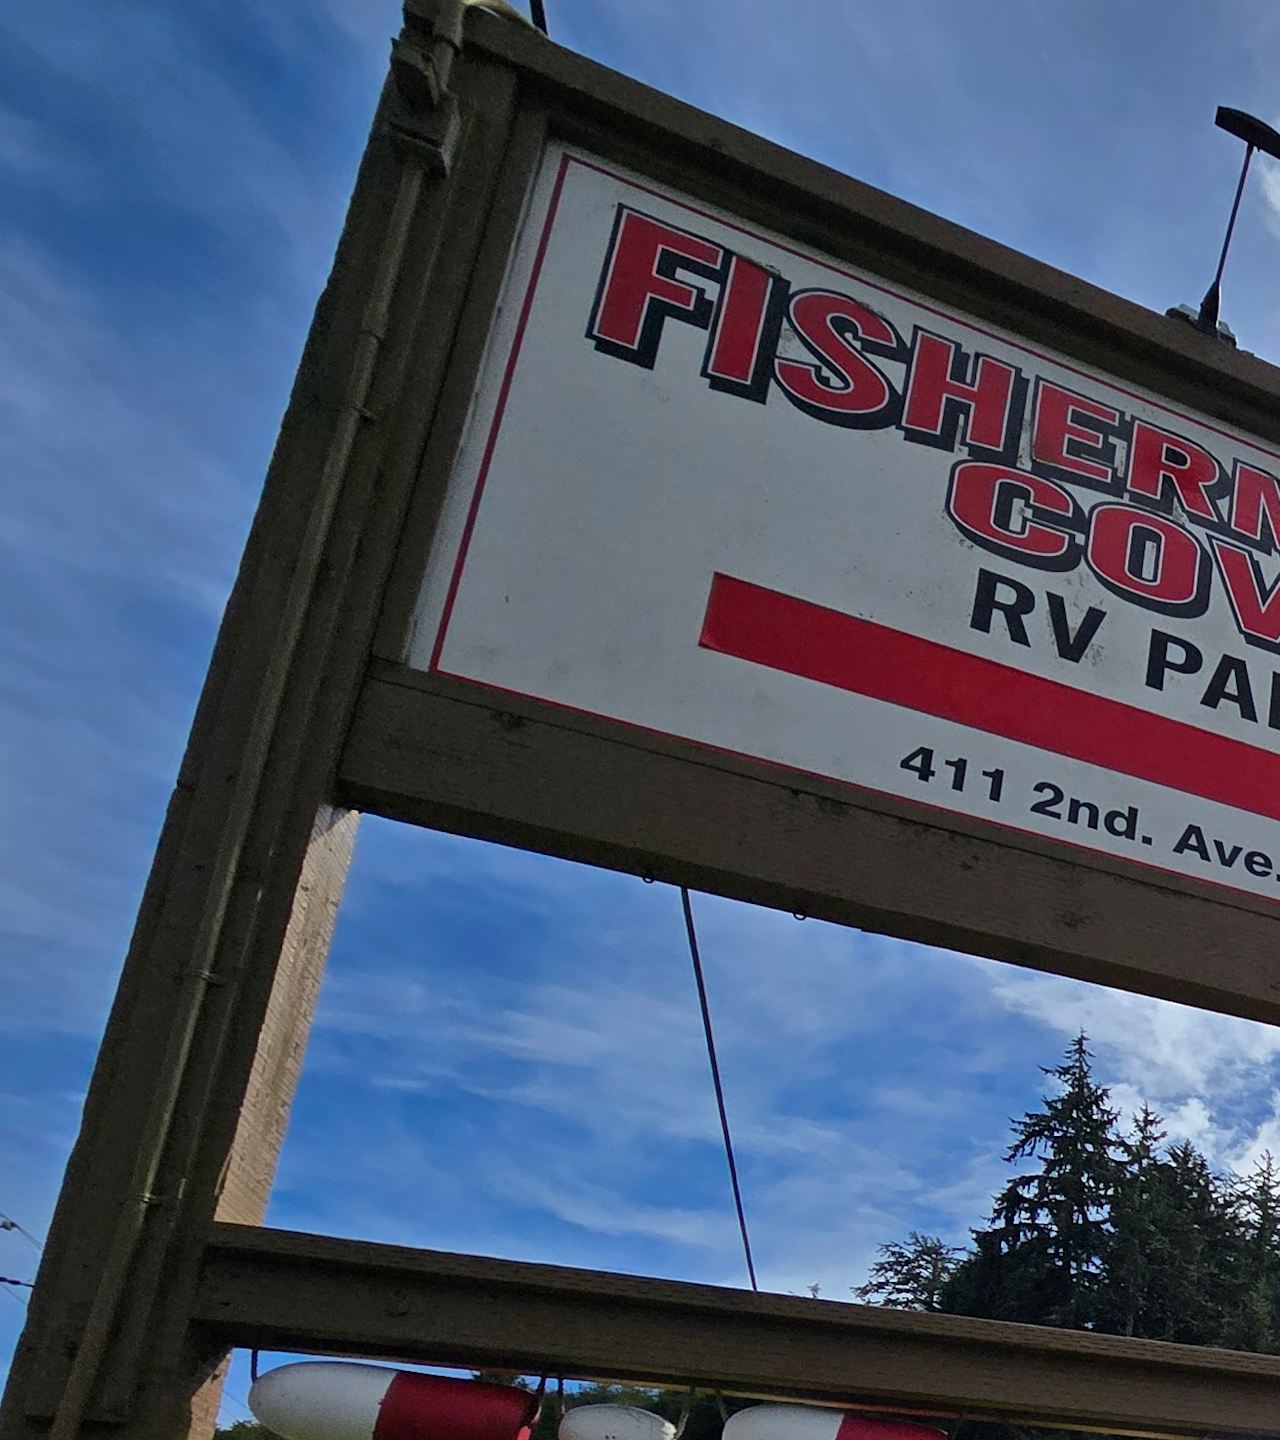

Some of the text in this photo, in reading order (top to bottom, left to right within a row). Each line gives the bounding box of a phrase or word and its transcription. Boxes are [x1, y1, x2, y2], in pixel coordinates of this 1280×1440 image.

[969, 569, 1106, 666] RV
[899, 746, 1006, 804] 411
[1030, 780, 1154, 848] 2nd.
